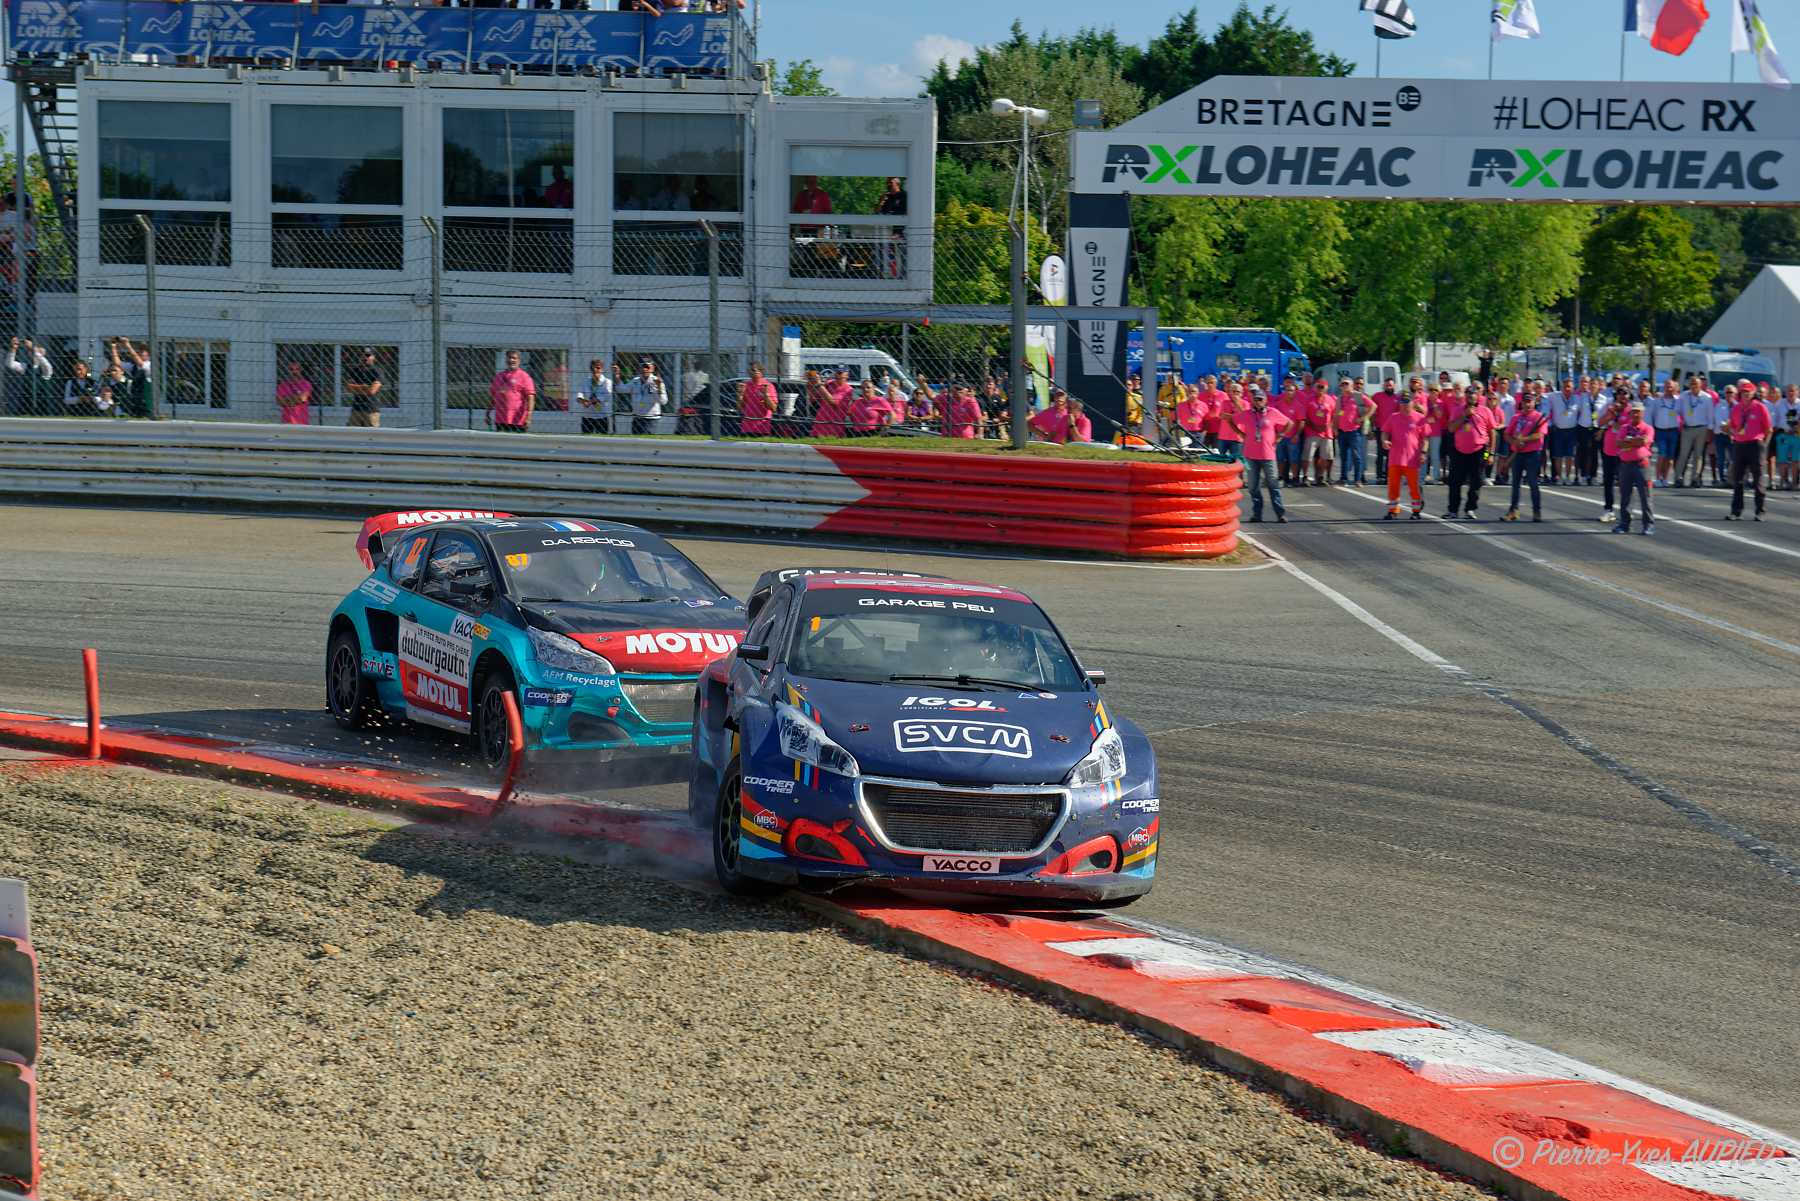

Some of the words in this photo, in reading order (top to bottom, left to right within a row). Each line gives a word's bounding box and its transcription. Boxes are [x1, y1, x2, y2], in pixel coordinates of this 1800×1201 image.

[189, 29, 256, 42] LOHEAC
[360, 33, 427, 47] LOHEAC
[1197, 97, 1392, 127] BRETAGNE
[1493, 96, 1685, 132] #LOHEAC
[1702, 100, 1756, 132] RX
[1091, 256, 1106, 354] BREAGNE
[858, 598, 946, 609] GARAGE
[952, 601, 995, 614] PEU
[566, 673, 616, 688] Recyclage
[417, 672, 462, 712] MOTUL
[901, 696, 997, 709] IGOL
[744, 776, 795, 788] COOPER
[756, 815, 775, 824] MBC
[1131, 833, 1148, 842] MBC
[932, 859, 992, 871] YACCO
